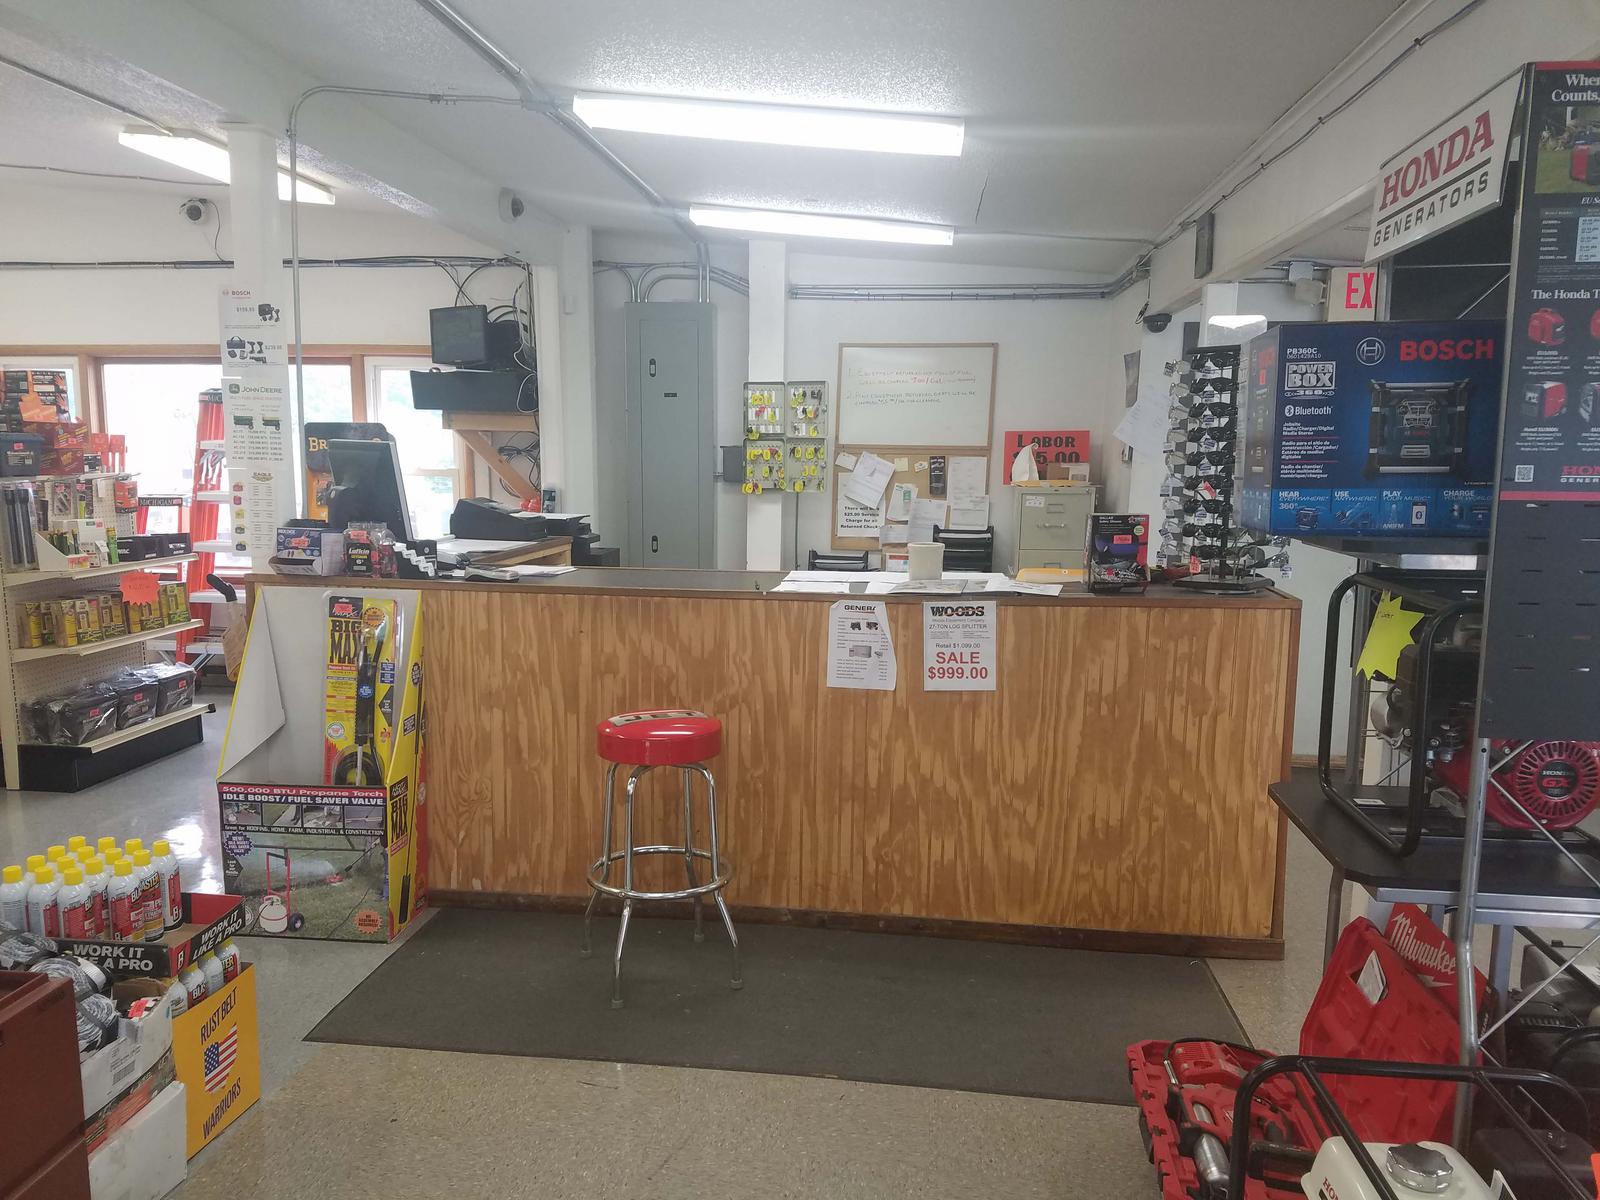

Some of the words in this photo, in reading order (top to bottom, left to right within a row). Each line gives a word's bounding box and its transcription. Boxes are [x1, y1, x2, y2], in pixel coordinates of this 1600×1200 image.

[1379, 110, 1495, 211] HONDA
[1373, 171, 1489, 247] GENERATORS
[1531, 289, 1552, 299] The
[1554, 289, 1590, 299] Honda
[1286, 347, 1318, 355] PB360C
[1400, 338, 1494, 361] BOSCH
[1288, 364, 1333, 374] POWER
[1287, 373, 1333, 388] BOX
[1295, 406, 1332, 416] Bluetooth
[1017, 434, 1077, 448] LABOR
[140, 498, 173, 506] MICHIGAN
[349, 547, 370, 555] Lufkin
[930, 606, 985, 617] WOODS
[331, 620, 361, 632] BIG
[936, 651, 980, 664] SALE
[928, 666, 988, 680] $999.00
[223, 793, 246, 801] IDLE
[315, 796, 349, 805] SAVER
[351, 798, 385, 806] VALVE
[299, 789, 348, 797] Propane
[202, 917, 230, 944] WORK
[230, 910, 238, 924] IT
[193, 937, 215, 960] LIKE
[215, 932, 222, 945] A
[224, 919, 242, 938] PRO
[1389, 911, 1457, 975] Milwaukee
[73, 943, 127, 958] WORK
[128, 947, 144, 958] IT
[103, 957, 114, 969] A
[119, 958, 153, 971] PRO
[200, 1007, 221, 1046] RUST
[221, 986, 237, 1021] BELT
[203, 1077, 241, 1140] WARRIORS
